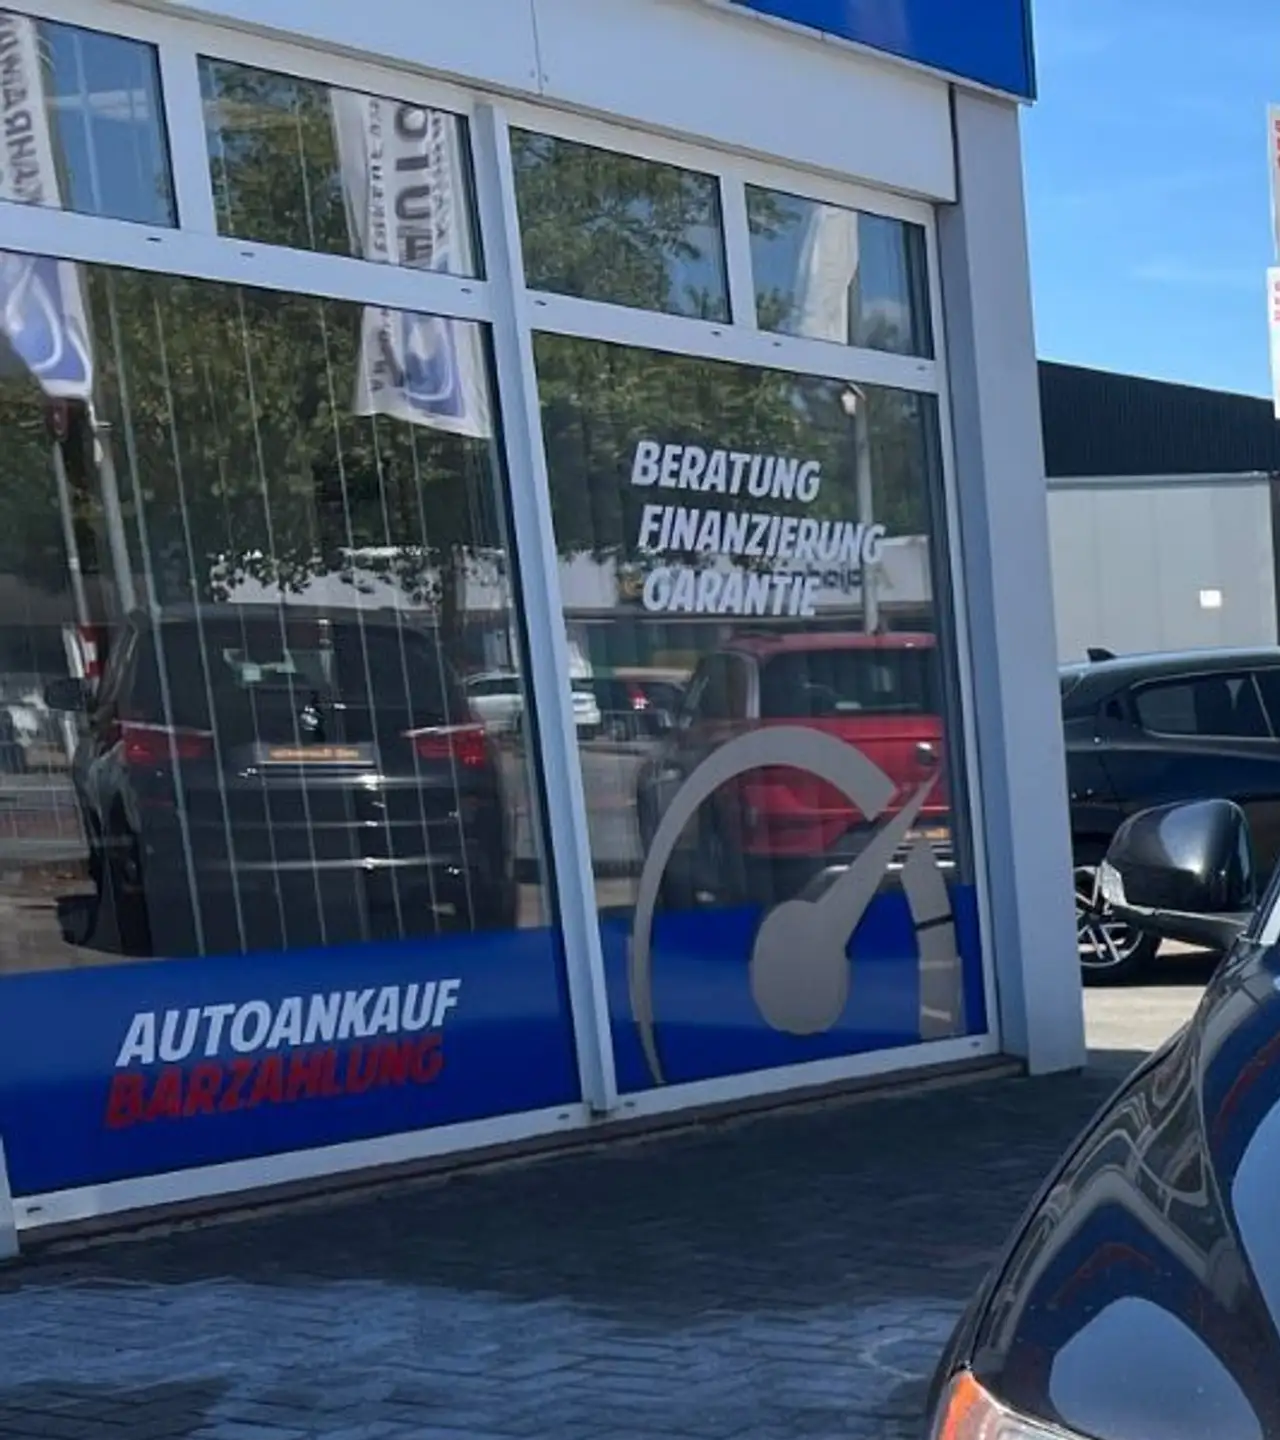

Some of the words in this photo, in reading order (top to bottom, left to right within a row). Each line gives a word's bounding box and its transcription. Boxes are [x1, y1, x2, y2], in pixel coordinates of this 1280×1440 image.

[631, 440, 822, 503] BERATUNG
[638, 504, 886, 564] FINANZIERUNG
[643, 567, 821, 616] GARANTIE
[115, 978, 461, 1067] AUTOANKAUF
[105, 1036, 447, 1131] BARZAHLUNG
